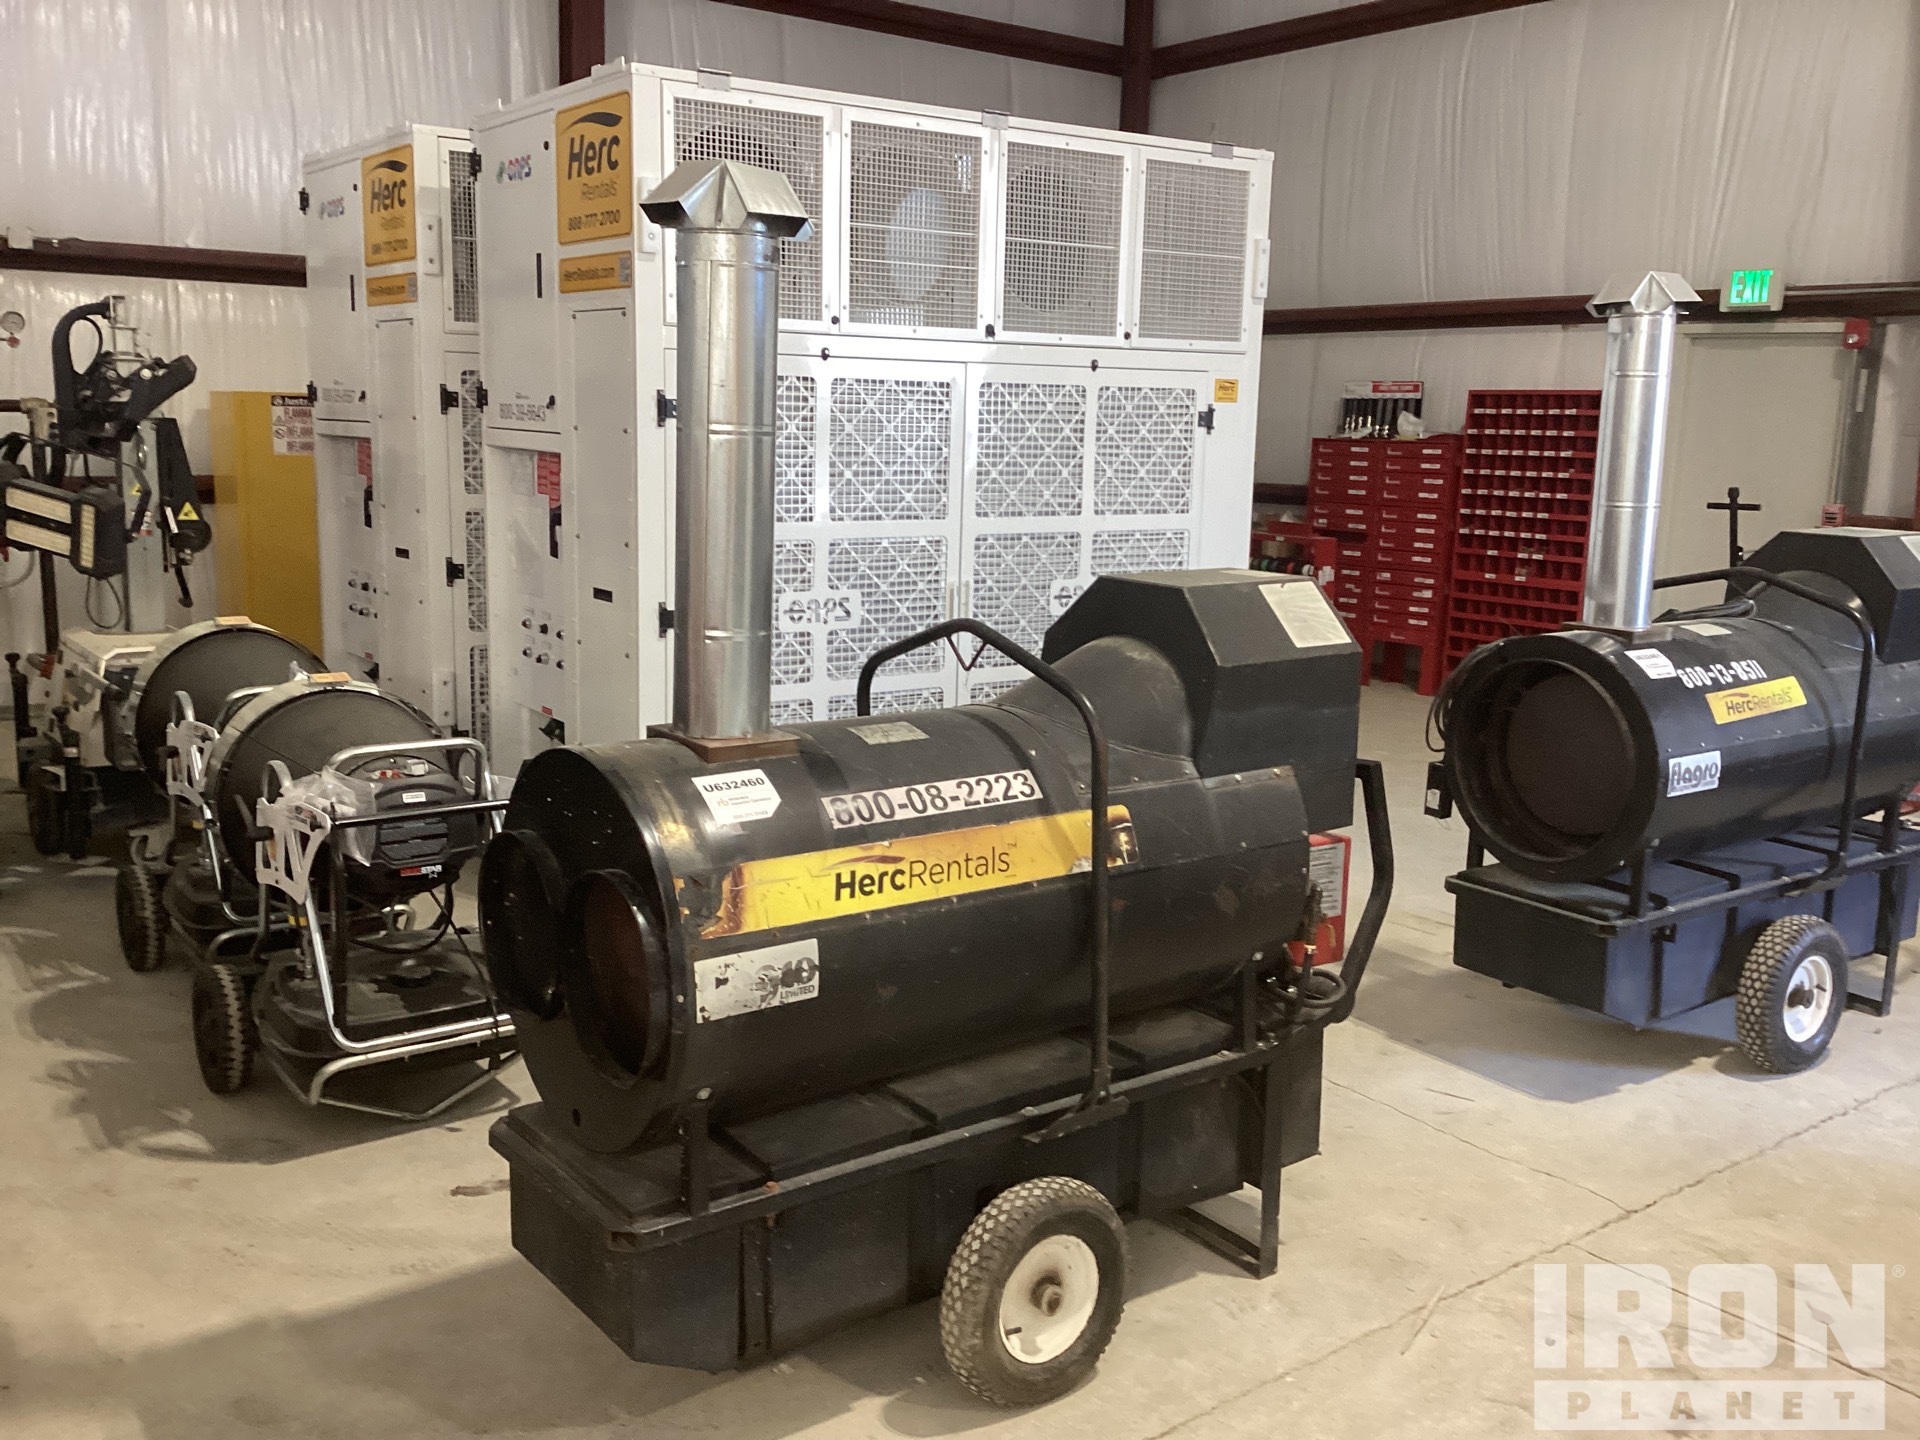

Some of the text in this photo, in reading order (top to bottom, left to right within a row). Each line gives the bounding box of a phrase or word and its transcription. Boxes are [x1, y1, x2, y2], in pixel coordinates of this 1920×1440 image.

[568, 134, 620, 180] Herc
[370, 178, 407, 213] Herc
[1730, 269, 1773, 304] EXIT
[1676, 659, 1768, 689] 800-13-8511
[702, 777, 766, 793] U632460
[830, 772, 1036, 826] 800-08-2223
